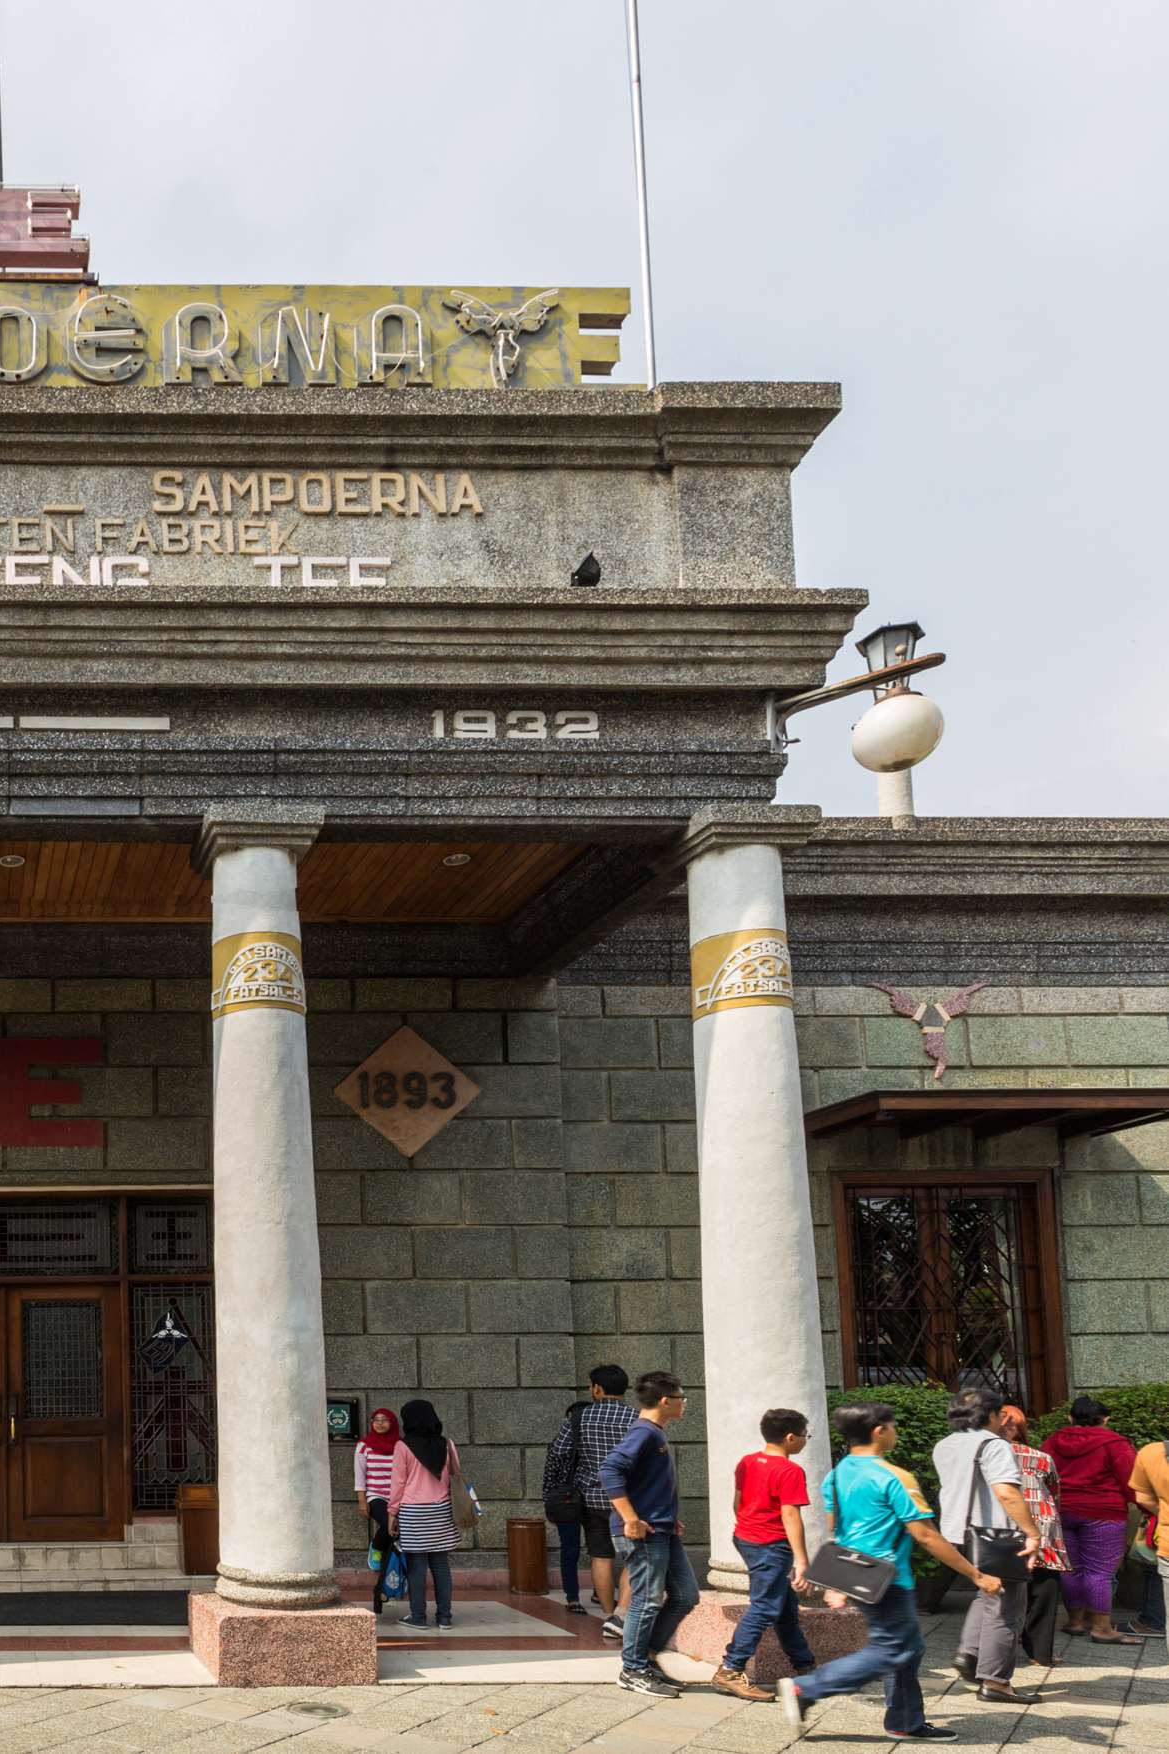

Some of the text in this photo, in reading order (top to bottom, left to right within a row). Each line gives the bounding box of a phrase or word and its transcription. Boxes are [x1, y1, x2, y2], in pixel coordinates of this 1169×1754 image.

[152, 470, 484, 516] SAMPOERNA
[95, 518, 303, 555] FABRIEK
[431, 709, 600, 739] 1932
[254, 946, 288, 960] SAM
[243, 960, 293, 984] 234
[357, 1071, 457, 1110] 1893
